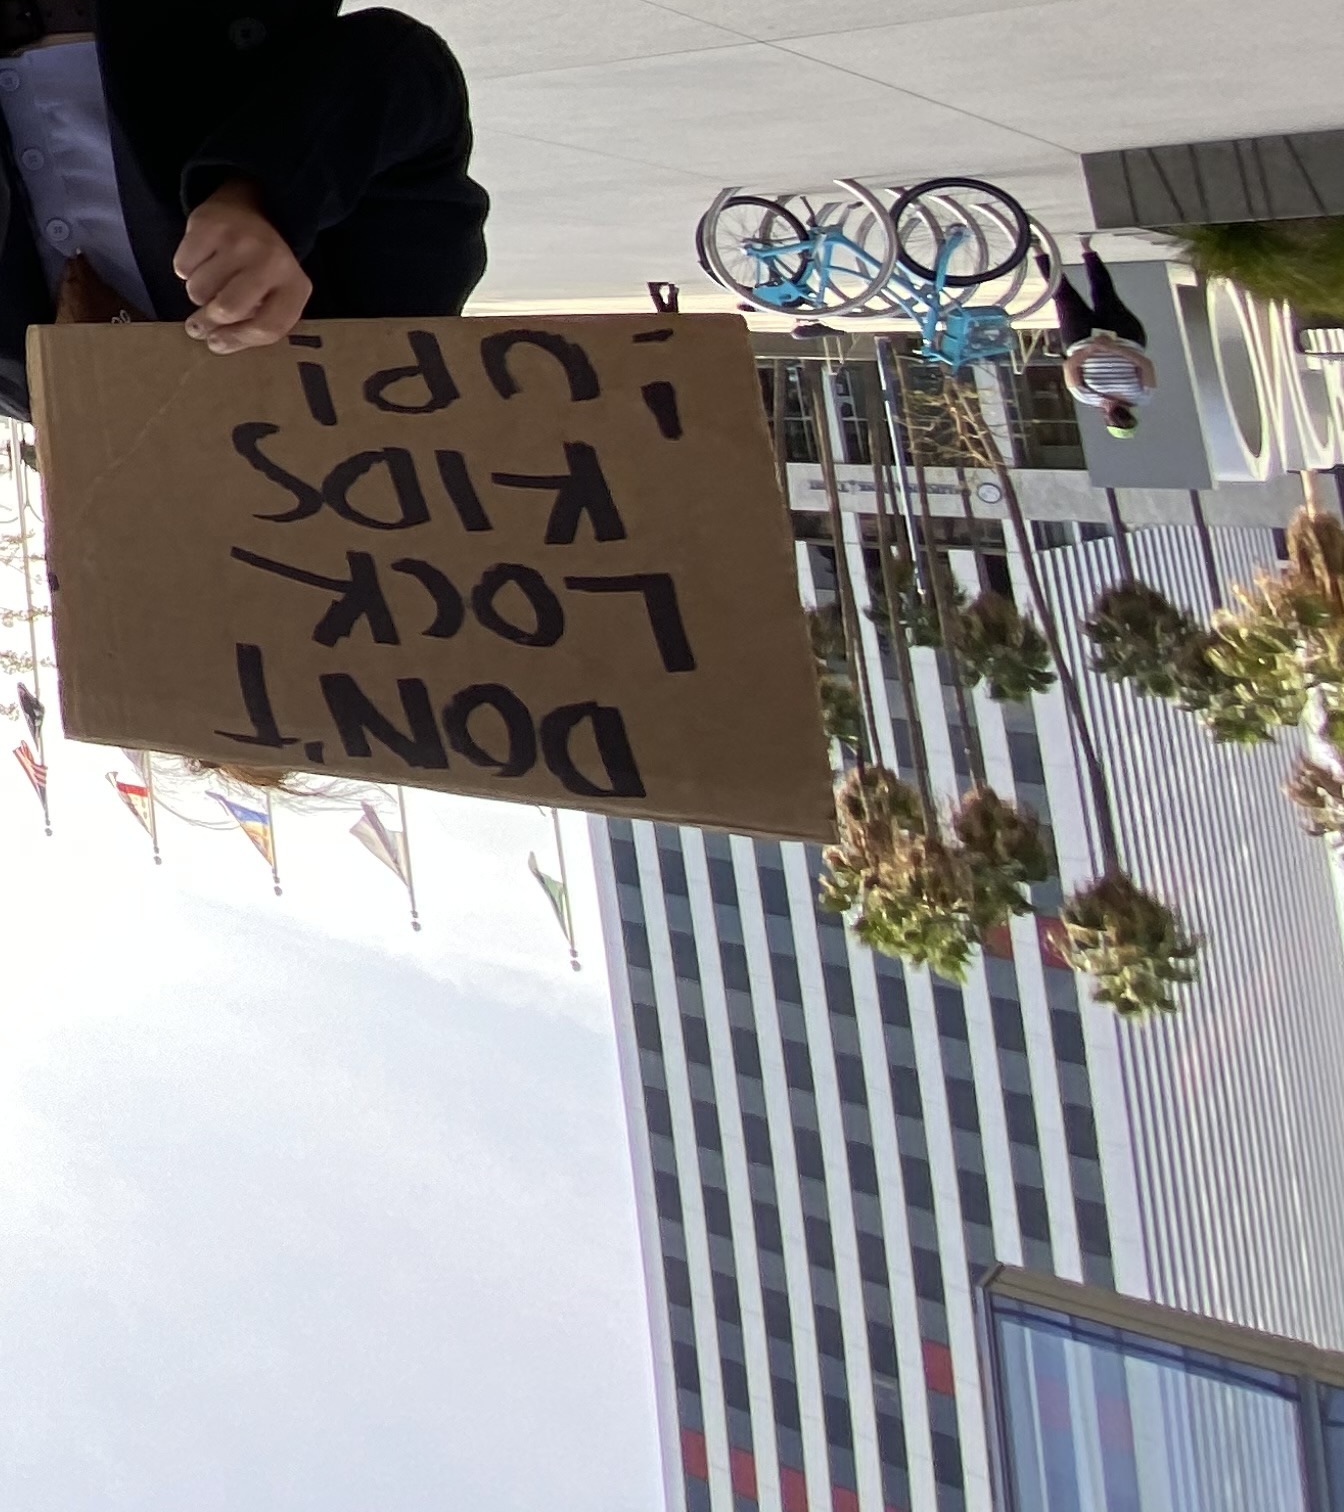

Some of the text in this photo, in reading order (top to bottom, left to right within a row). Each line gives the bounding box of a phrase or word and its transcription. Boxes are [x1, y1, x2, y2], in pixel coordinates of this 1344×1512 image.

[232, 422, 627, 545] KIDS
[231, 547, 697, 673] LOCK
[215, 643, 646, 798] DON'T
